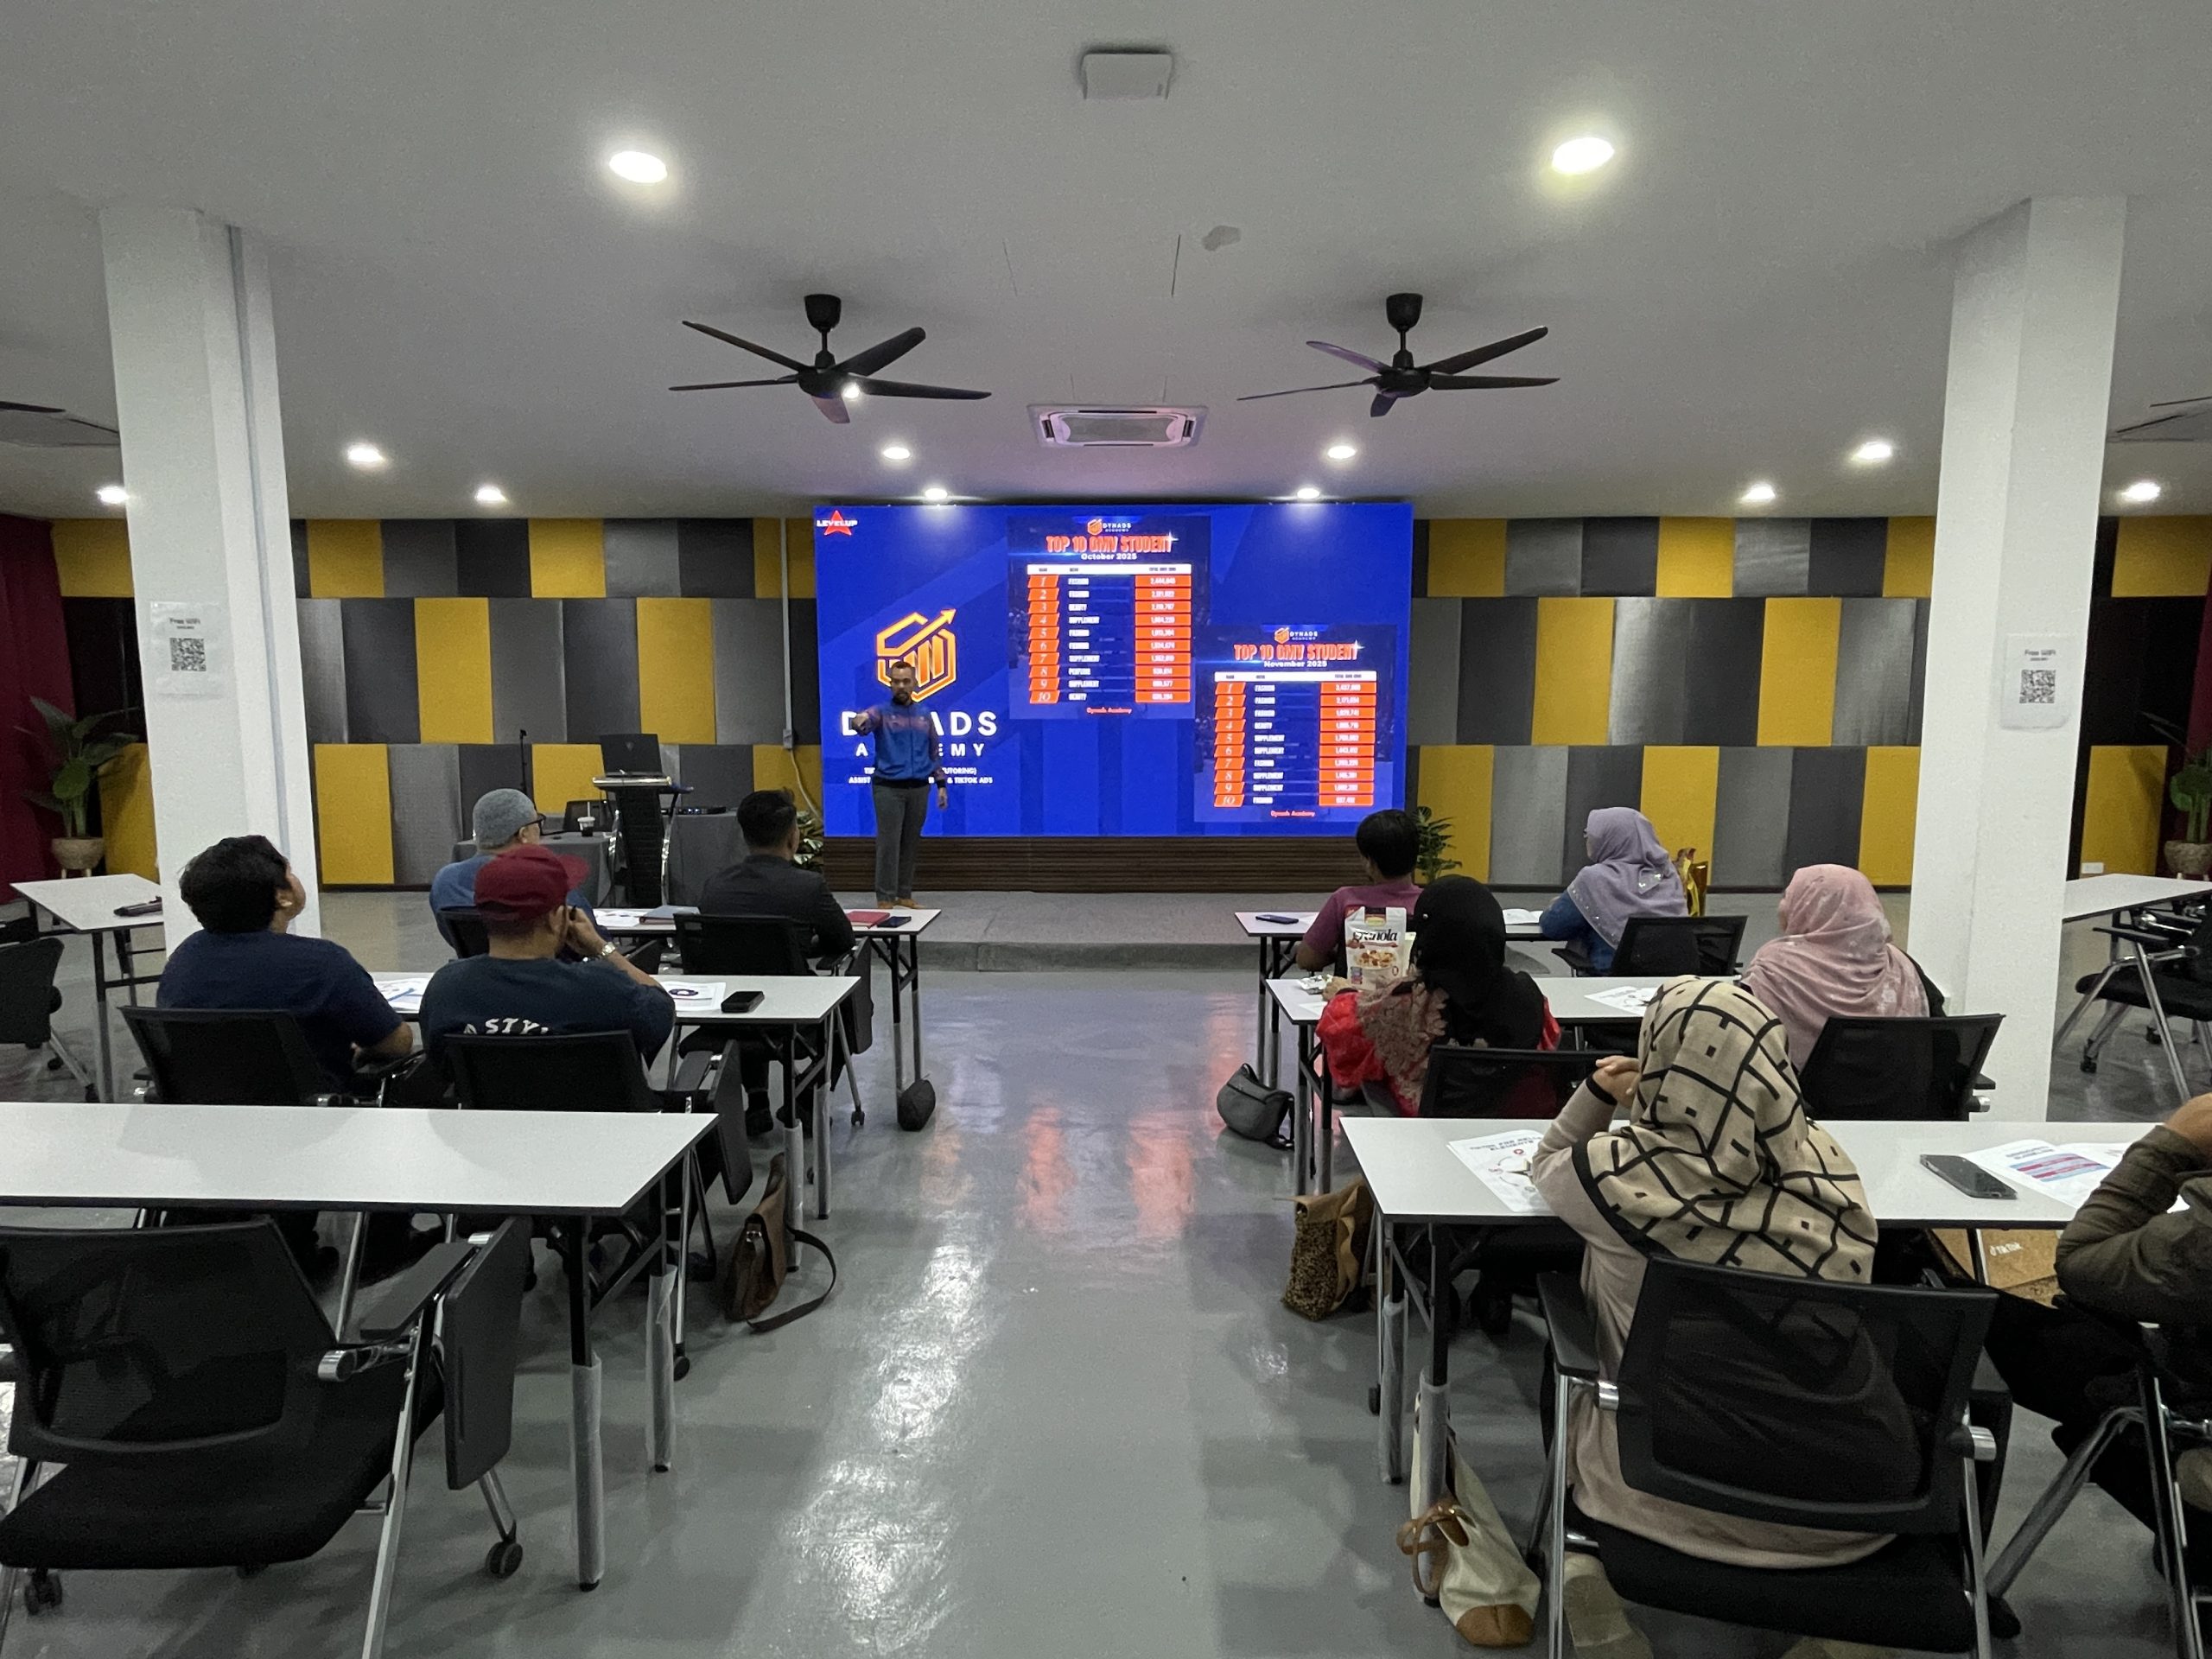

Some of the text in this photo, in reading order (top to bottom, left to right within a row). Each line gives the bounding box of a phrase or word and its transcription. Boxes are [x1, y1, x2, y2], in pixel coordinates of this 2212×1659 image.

[1046, 536, 1070, 553] TOP
[1072, 536, 1087, 553] 10
[1120, 536, 1173, 553] STUDENT
[1040, 577, 1046, 586] 1
[1039, 590, 1046, 599] 2
[1041, 602, 1046, 612] 3
[1040, 616, 1046, 625] 4
[1040, 628, 1047, 638] 5
[1040, 641, 1046, 650] 6
[1234, 644, 1358, 660] TOP 10 GMV STUDENT
[1040, 654, 1047, 663] 7
[1040, 667, 1047, 677] 8
[1040, 679, 1047, 689] 9
[1227, 683, 1233, 692] 1
[1038, 692, 1051, 701] 10
[1227, 709, 1232, 717] 3
[842, 711, 997, 736] DADS
[1226, 721, 1232, 730] 4
[1226, 734, 1232, 742] 5
[1225, 759, 1232, 767] 7
[942, 767, 977, 776] UTORING)
[1225, 784, 1232, 792] 9
[1222, 796, 1236, 804] 10
